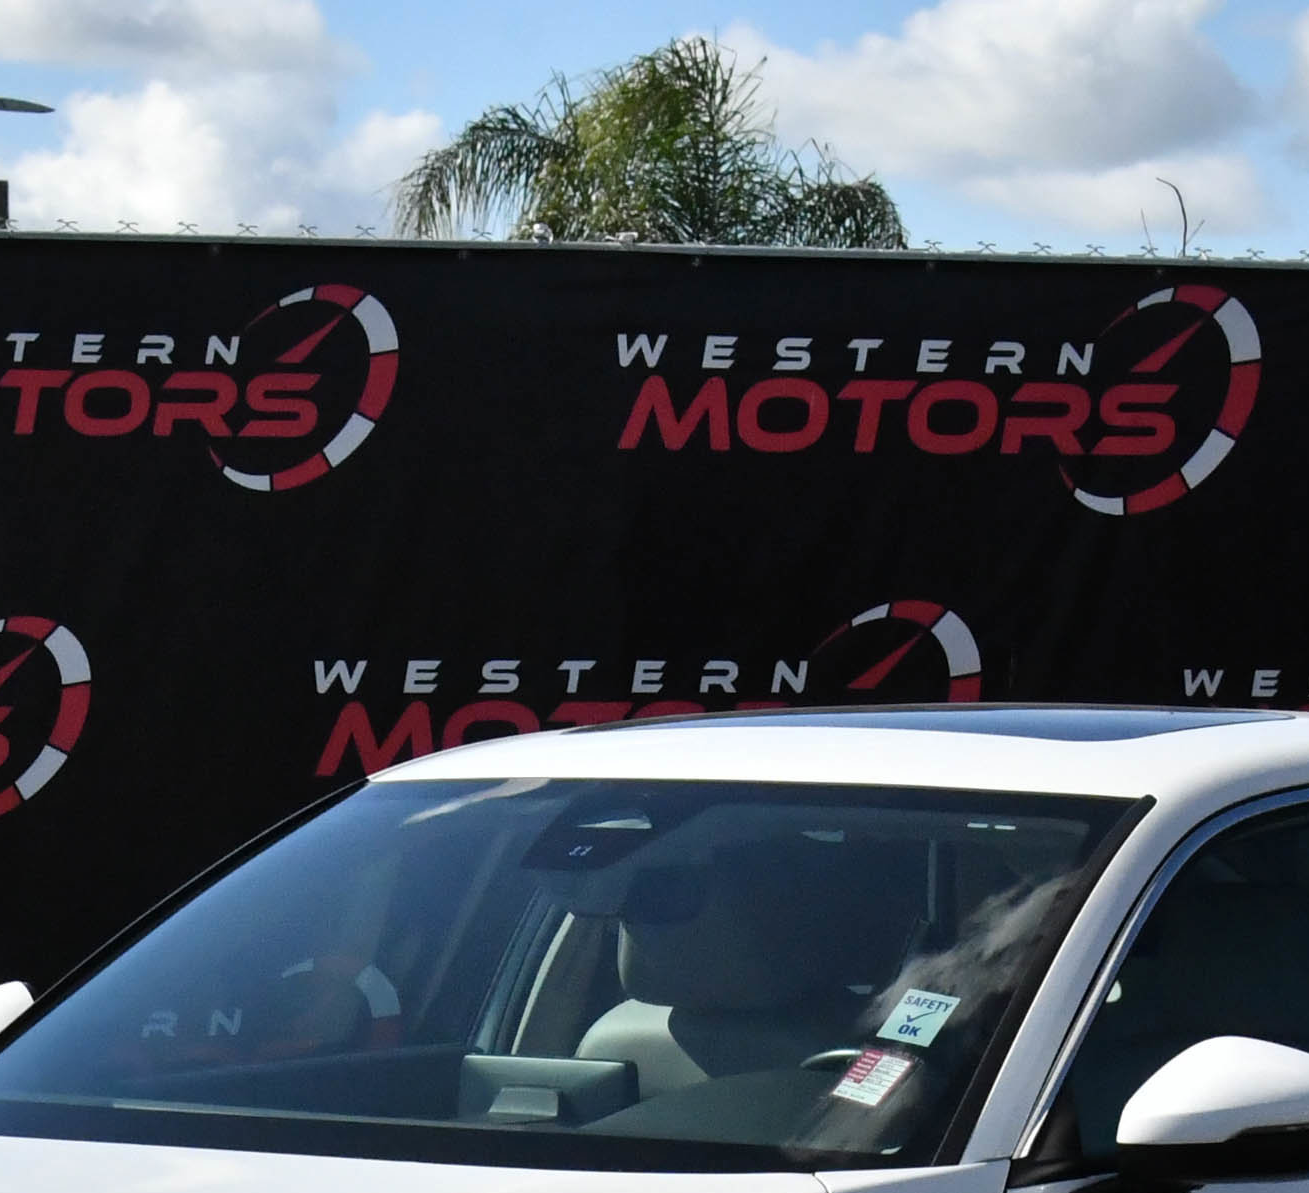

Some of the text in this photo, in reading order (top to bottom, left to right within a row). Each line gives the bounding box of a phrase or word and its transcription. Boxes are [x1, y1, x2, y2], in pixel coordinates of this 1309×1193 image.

[618, 335, 1093, 374] WESTERN
[621, 376, 1177, 455] MOTORS
[315, 661, 807, 693] WESTERN
[904, 995, 954, 1013] SAFETY
[898, 1023, 923, 1037] OK
